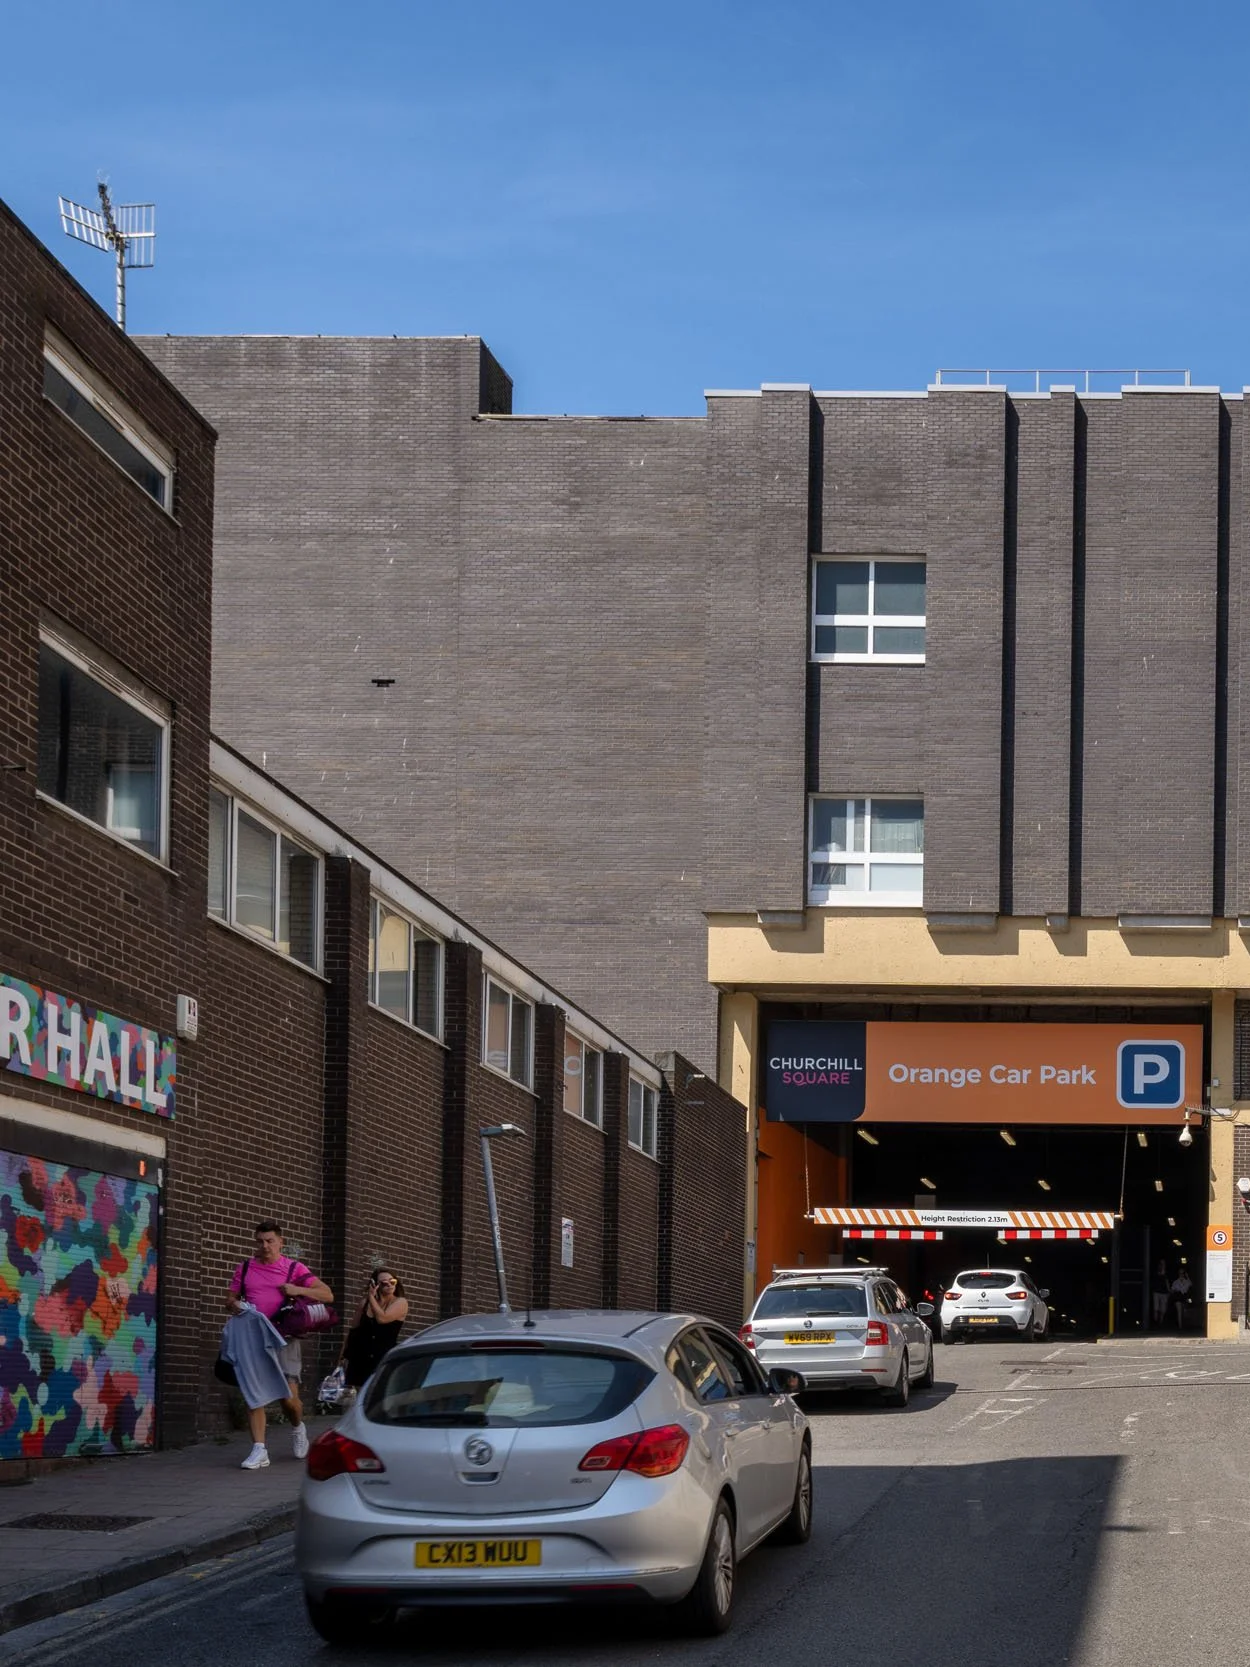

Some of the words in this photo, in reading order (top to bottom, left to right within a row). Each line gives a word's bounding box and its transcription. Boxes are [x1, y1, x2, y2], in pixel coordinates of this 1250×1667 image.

[48, 1002, 166, 1108] HALL
[770, 1058, 863, 1070] CHURCHILL
[782, 1072, 850, 1086] SQUARE
[889, 1063, 981, 1088] Orange
[989, 1064, 1032, 1084] Car
[1040, 1064, 1096, 1085] Park
[1133, 1054, 1170, 1094] P
[921, 1215, 945, 1223] Height
[947, 1215, 986, 1223] Restriction
[1217, 1233, 1223, 1241] 5
[813, 1331, 832, 1341] RPX
[428, 1543, 477, 1563] CX13
